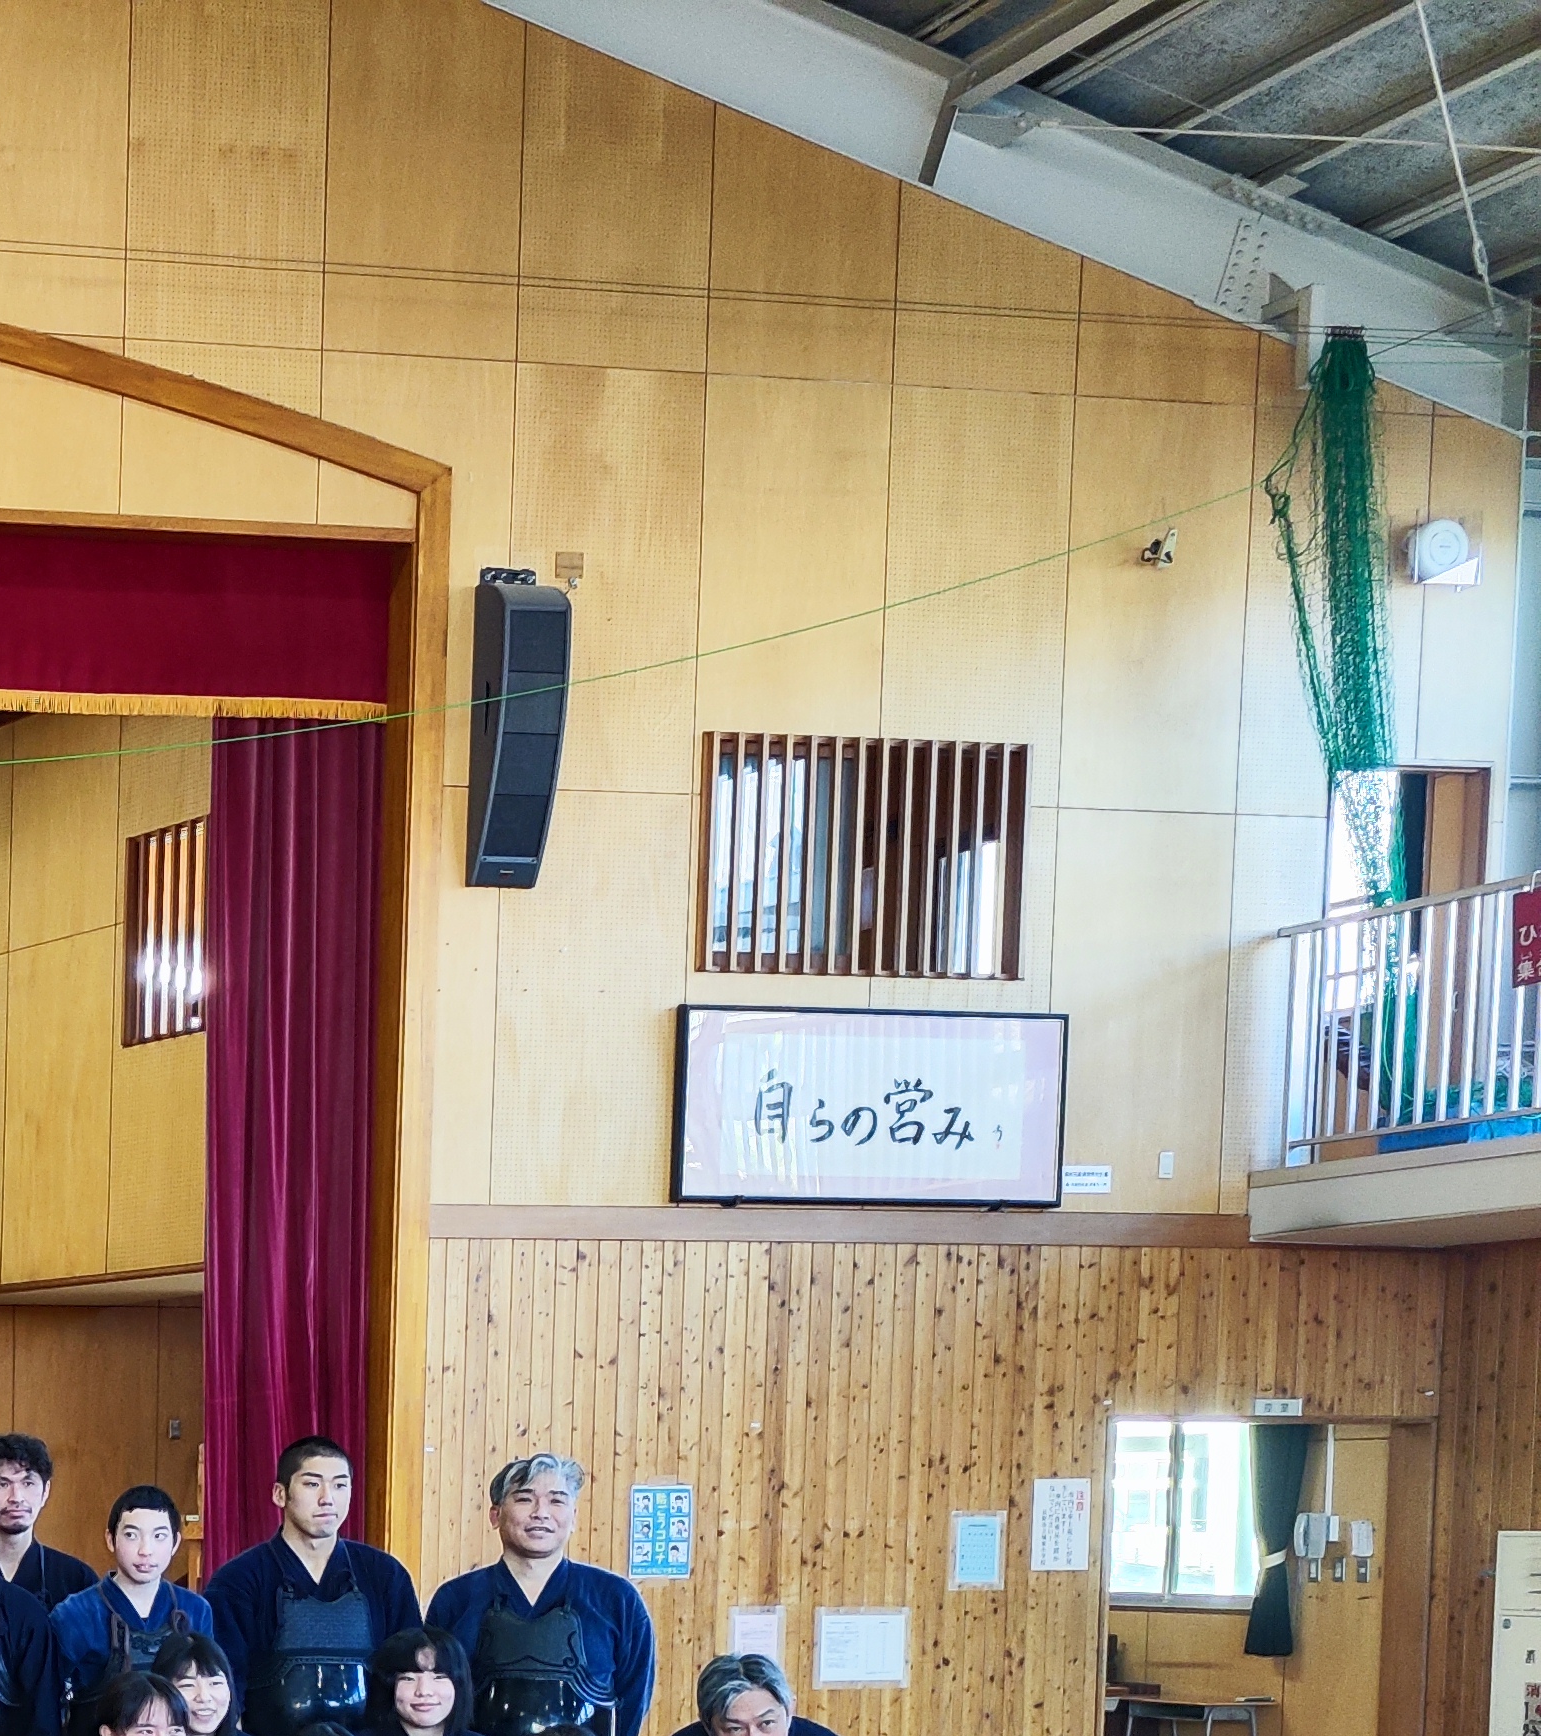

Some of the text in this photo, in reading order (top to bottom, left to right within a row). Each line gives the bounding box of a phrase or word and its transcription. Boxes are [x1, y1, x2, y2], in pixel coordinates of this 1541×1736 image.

[753, 1068, 975, 1151] 自らの営み
